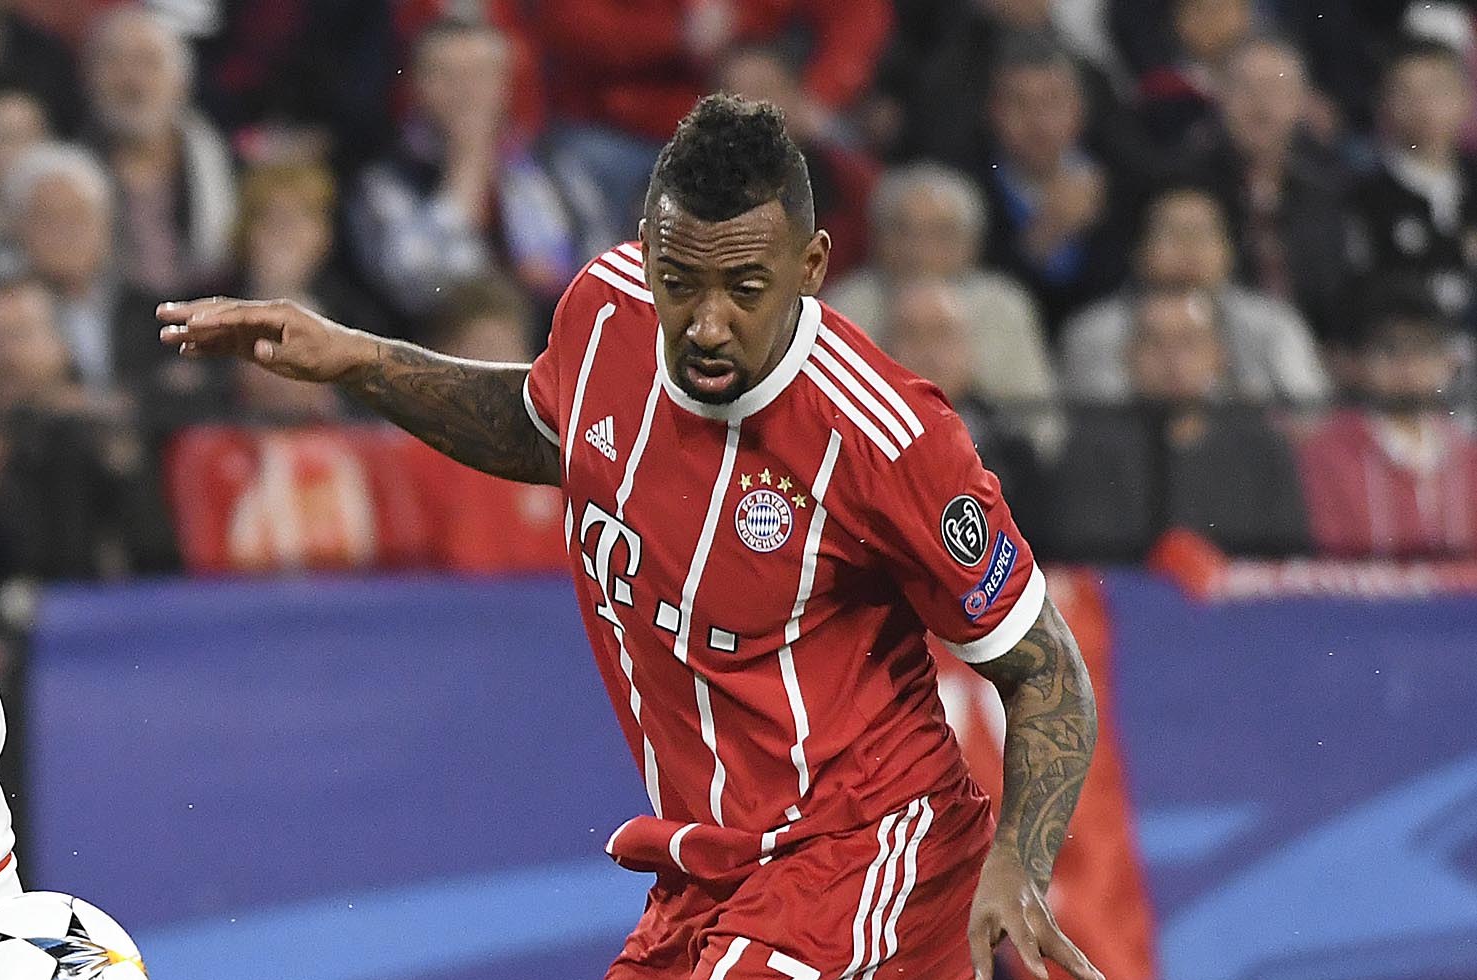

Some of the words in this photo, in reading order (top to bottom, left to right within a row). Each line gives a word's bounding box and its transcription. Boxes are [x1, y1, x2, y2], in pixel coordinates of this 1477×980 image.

[584, 427, 618, 463] adidas
[755, 492, 790, 525] BAYERN
[984, 535, 1013, 597] RESPECT
